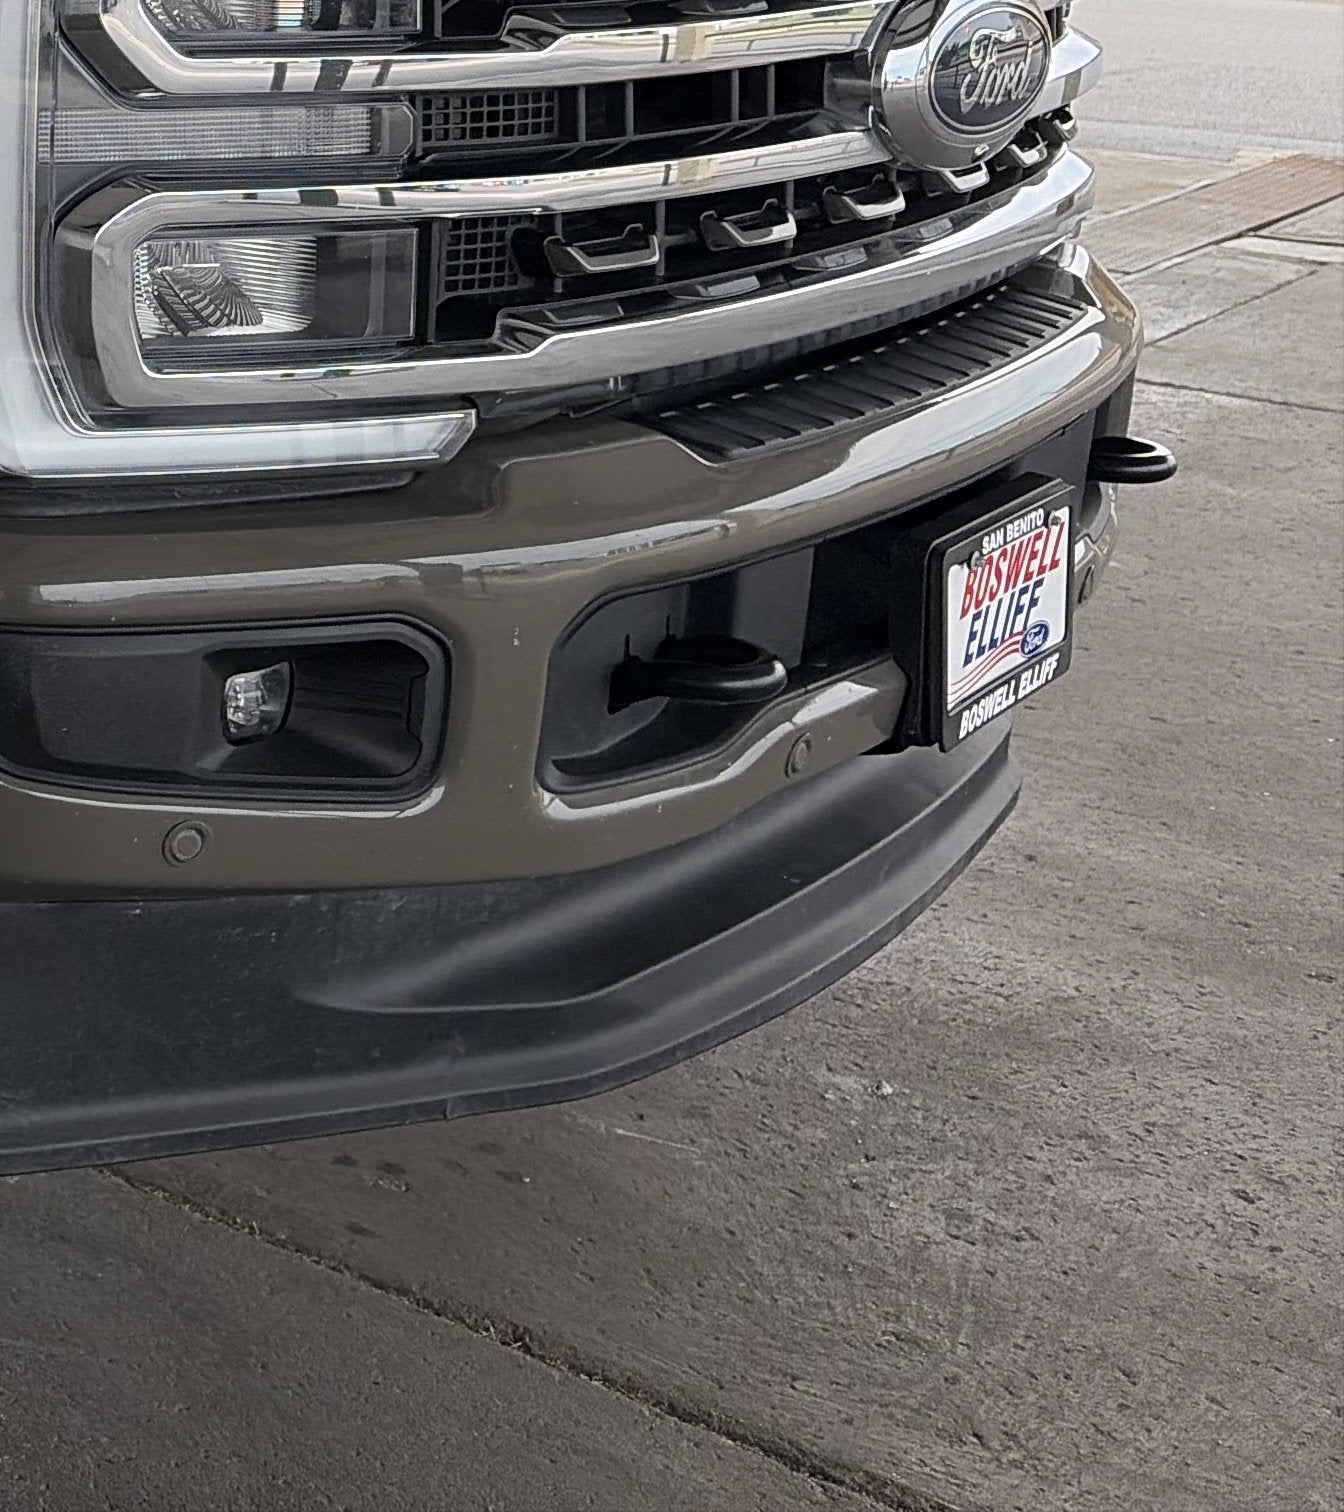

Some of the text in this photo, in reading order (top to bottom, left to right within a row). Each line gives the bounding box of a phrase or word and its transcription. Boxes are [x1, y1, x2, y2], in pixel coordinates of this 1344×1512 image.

[960, 25, 1035, 115] Ford
[959, 519, 1066, 621] BOSWELL
[982, 508, 1045, 555] SAN BENITO
[962, 576, 1046, 669] ELLIFF
[959, 651, 1060, 740] BOSWELL ELLIFF
